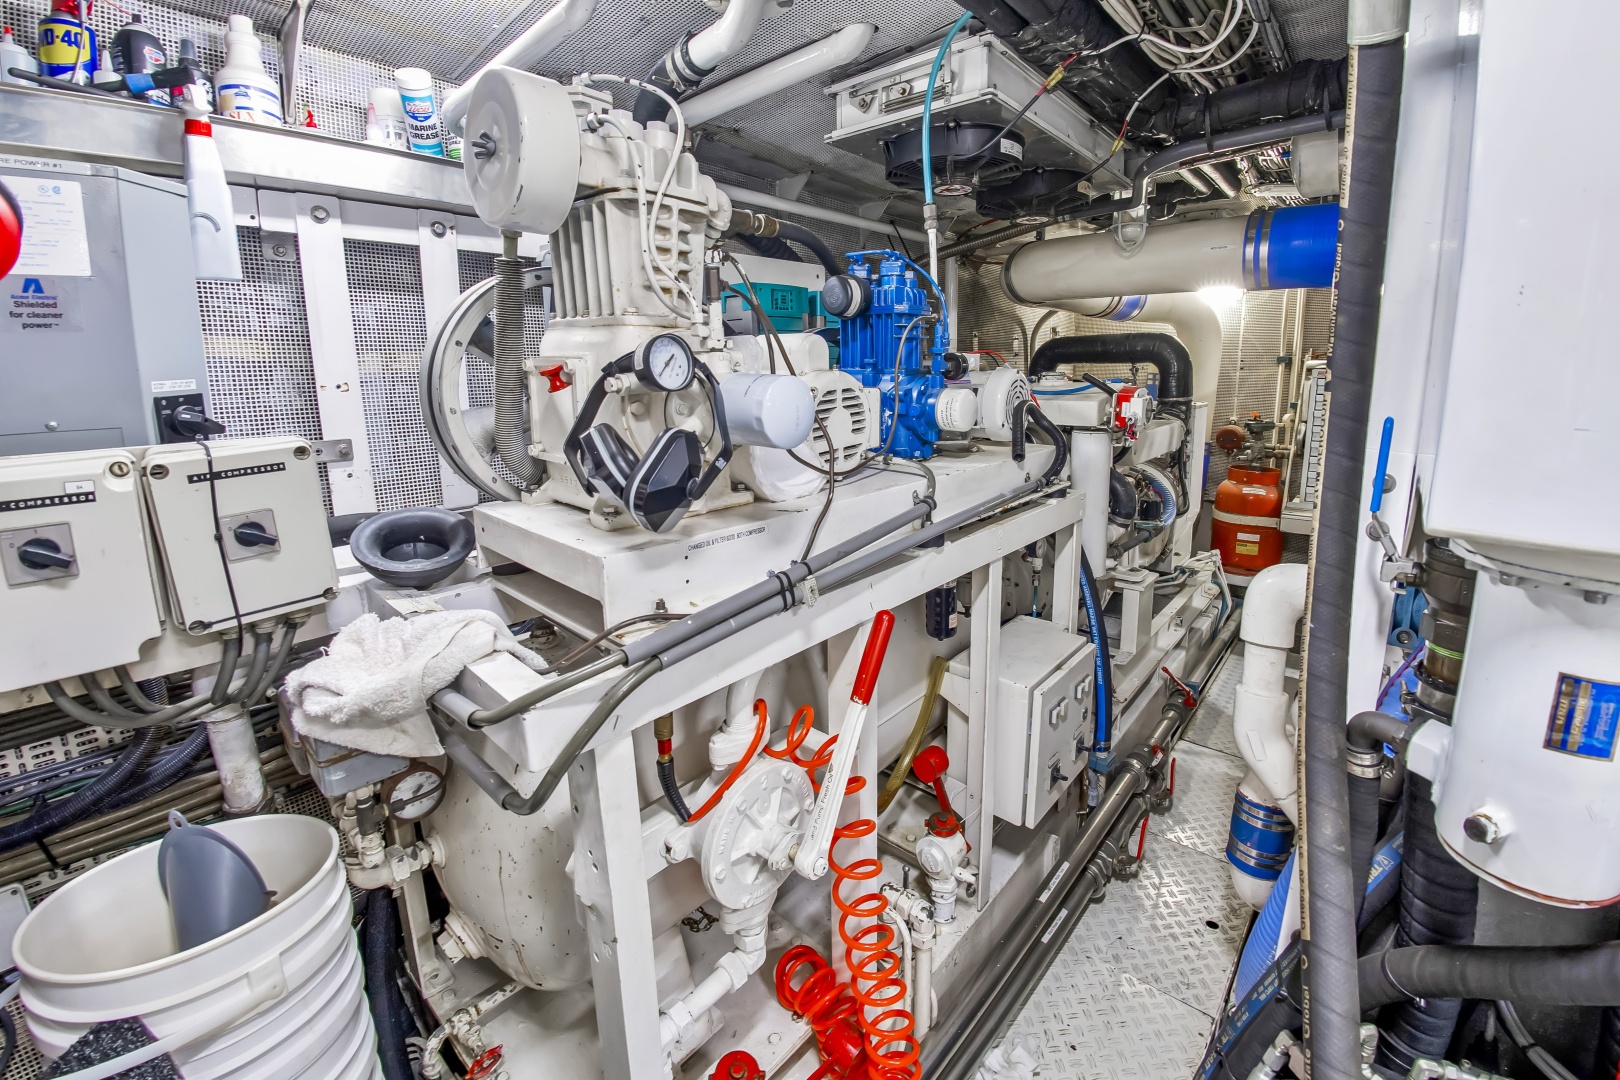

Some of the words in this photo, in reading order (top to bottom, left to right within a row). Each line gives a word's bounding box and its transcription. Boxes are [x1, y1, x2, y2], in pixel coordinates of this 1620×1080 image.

[408, 122, 438, 132] MARINE
[410, 131, 439, 140] GREASE
[1334, 243, 1342, 282] Global
[13, 300, 58, 308] Shielded
[9, 310, 24, 318] for
[221, 464, 284, 478] COMPRESSOR
[688, 541, 705, 551] CHANGED
[715, 536, 726, 544] FILTER
[746, 526, 766, 536] COMPRESSOR
